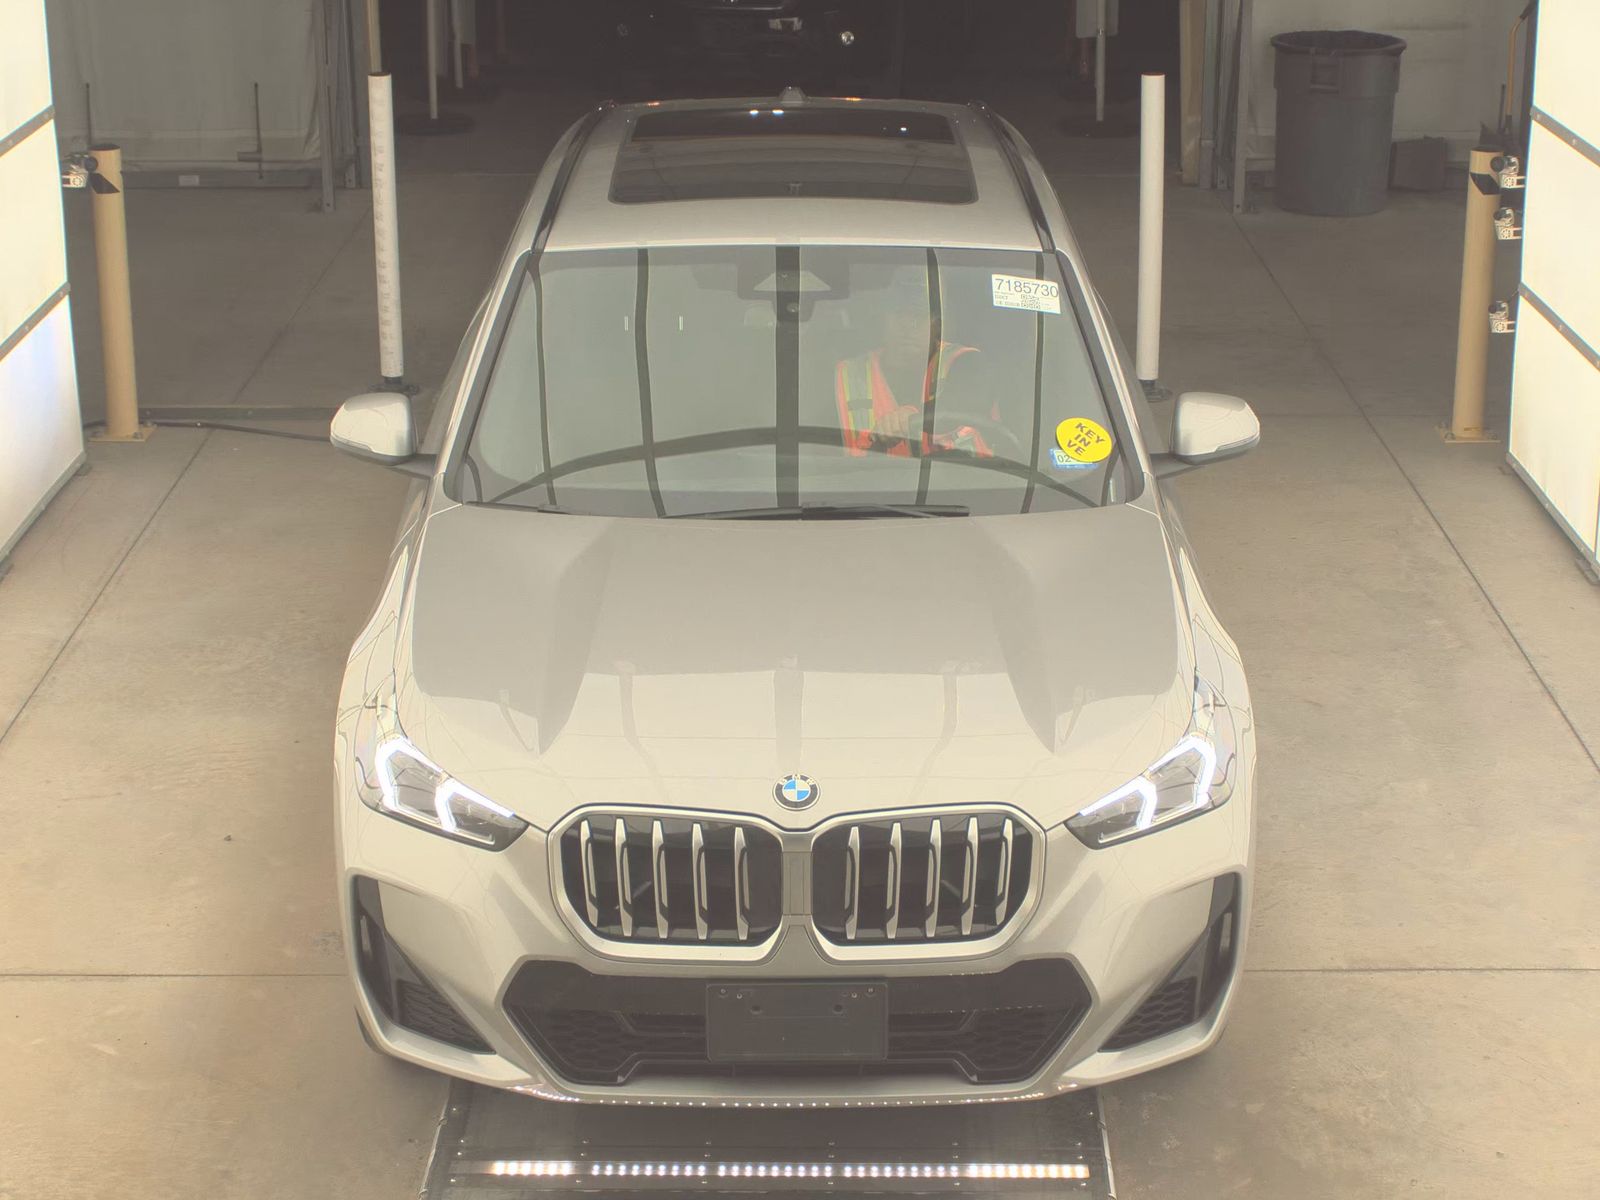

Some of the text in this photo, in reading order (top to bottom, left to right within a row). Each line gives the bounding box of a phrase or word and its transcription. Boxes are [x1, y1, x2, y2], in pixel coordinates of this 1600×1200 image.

[994, 278, 1059, 298] 7185730
[1074, 434, 1091, 448] IN
[1075, 422, 1106, 444] KEY
[1067, 440, 1086, 457] VE
